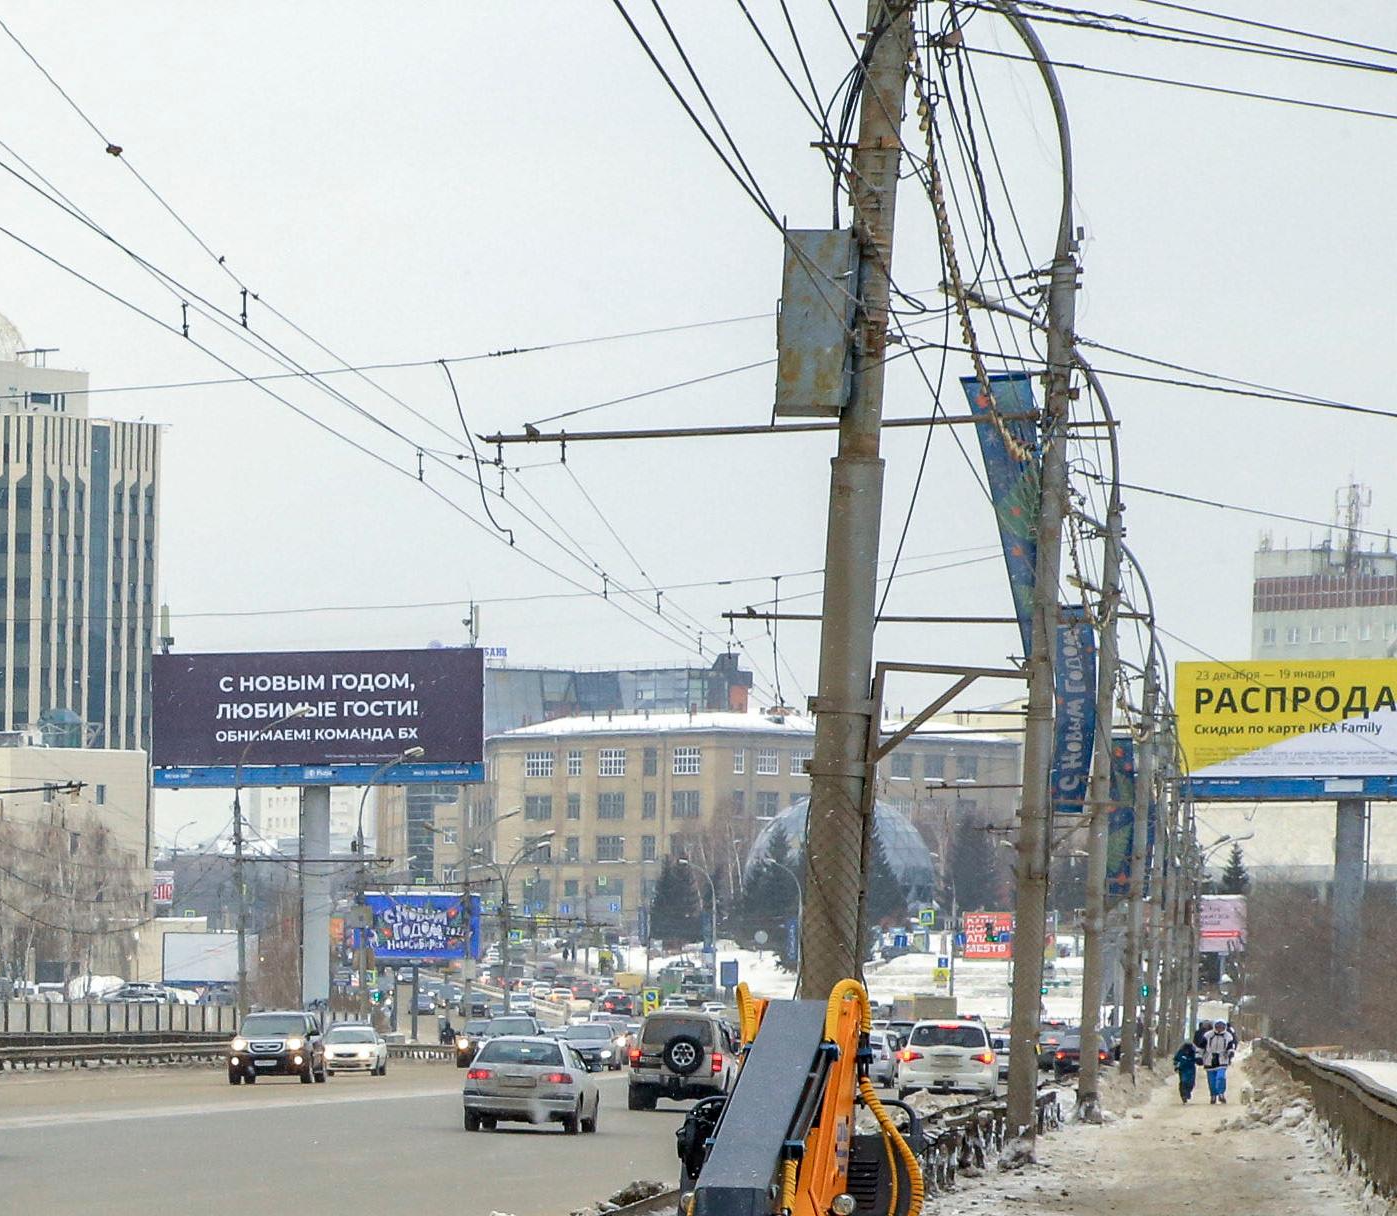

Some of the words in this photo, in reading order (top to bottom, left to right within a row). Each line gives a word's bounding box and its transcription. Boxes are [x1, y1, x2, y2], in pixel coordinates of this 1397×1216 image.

[219, 676, 234, 693] С
[240, 674, 325, 692] НОВЫМ
[332, 673, 415, 692] ГОДОМ,
[1196, 670, 1210, 681] 23
[1212, 669, 1260, 682] декабря
[1279, 669, 1291, 679] 19
[1294, 670, 1335, 680] января
[216, 702, 337, 720] ЛЮБИМЫЕ
[344, 700, 419, 717] ГОСТИ!
[1195, 685, 1397, 719] РАСПРОДА
[215, 729, 311, 742] ОБНИМАЕМ!
[315, 728, 392, 741] КОМАНДА
[399, 727, 418, 740] БХ
[1194, 724, 1244, 736] Скидки
[1248, 725, 1264, 734] по
[1268, 724, 1305, 735] карте
[1309, 722, 1337, 733] IKEA
[1341, 722, 1383, 736] Family
